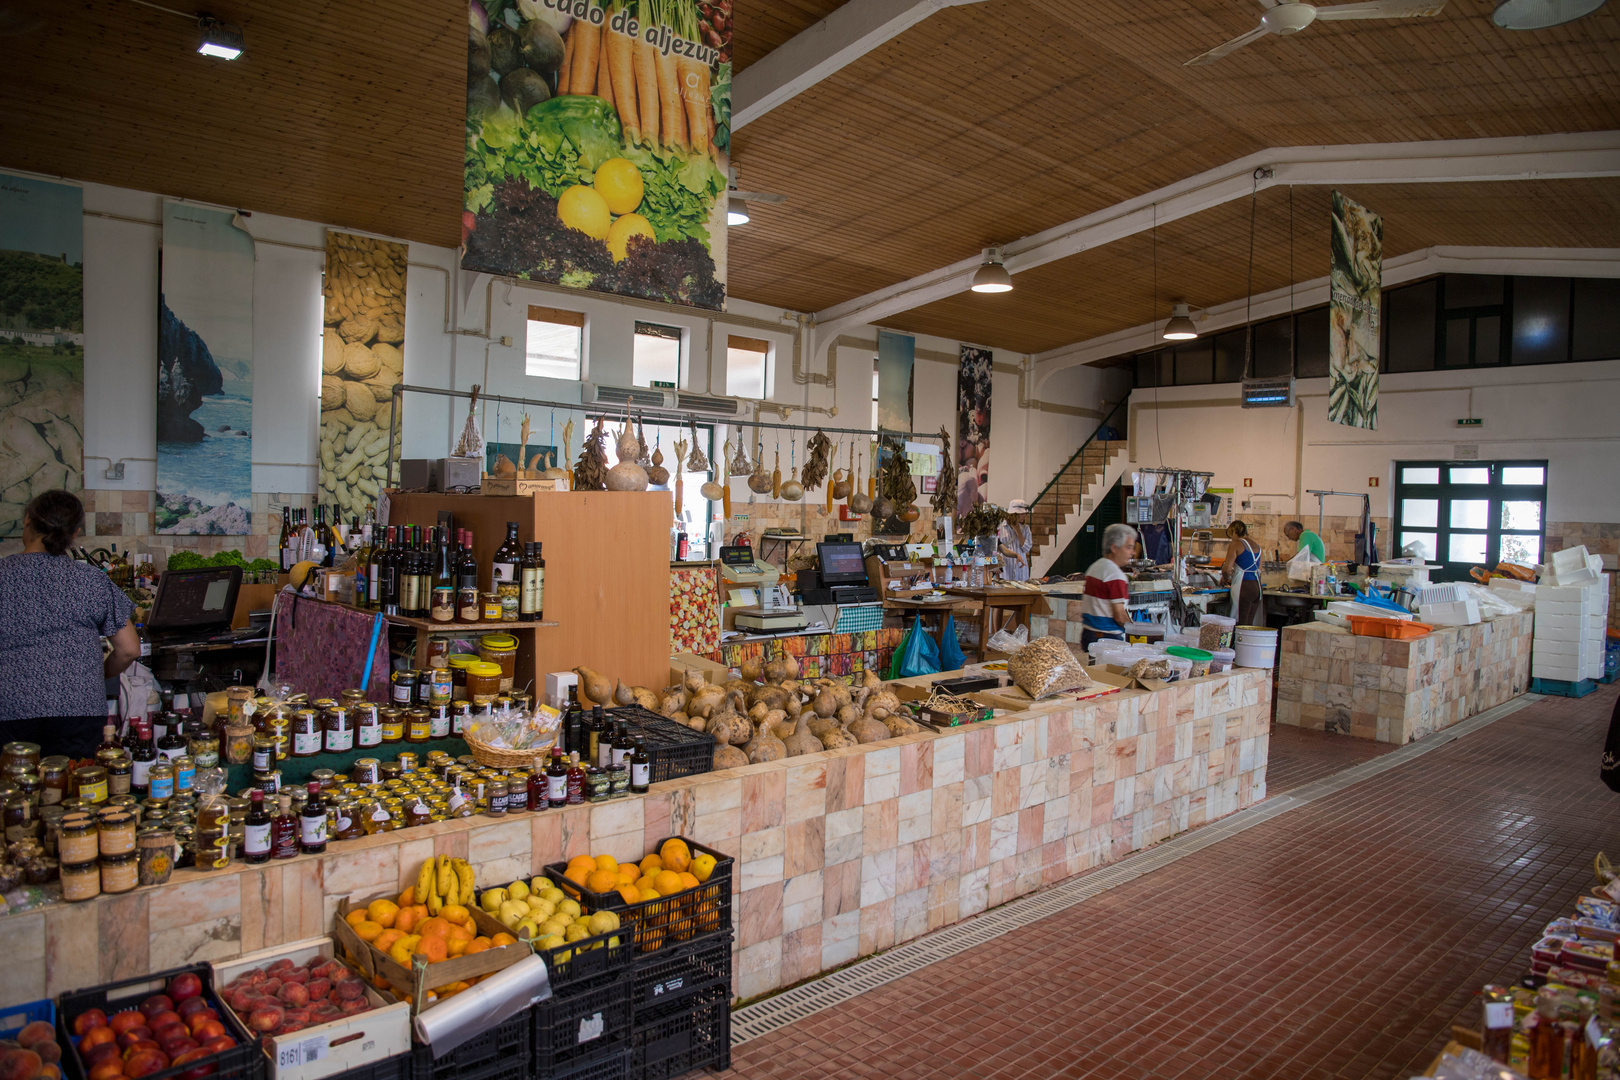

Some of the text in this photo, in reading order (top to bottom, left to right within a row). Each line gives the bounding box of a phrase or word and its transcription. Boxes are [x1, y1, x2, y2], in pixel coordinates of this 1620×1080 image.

[533, 0, 720, 66] cado de aljezur
[673, 87, 710, 103] aljezur
[280, 1048, 299, 1067] 8161
